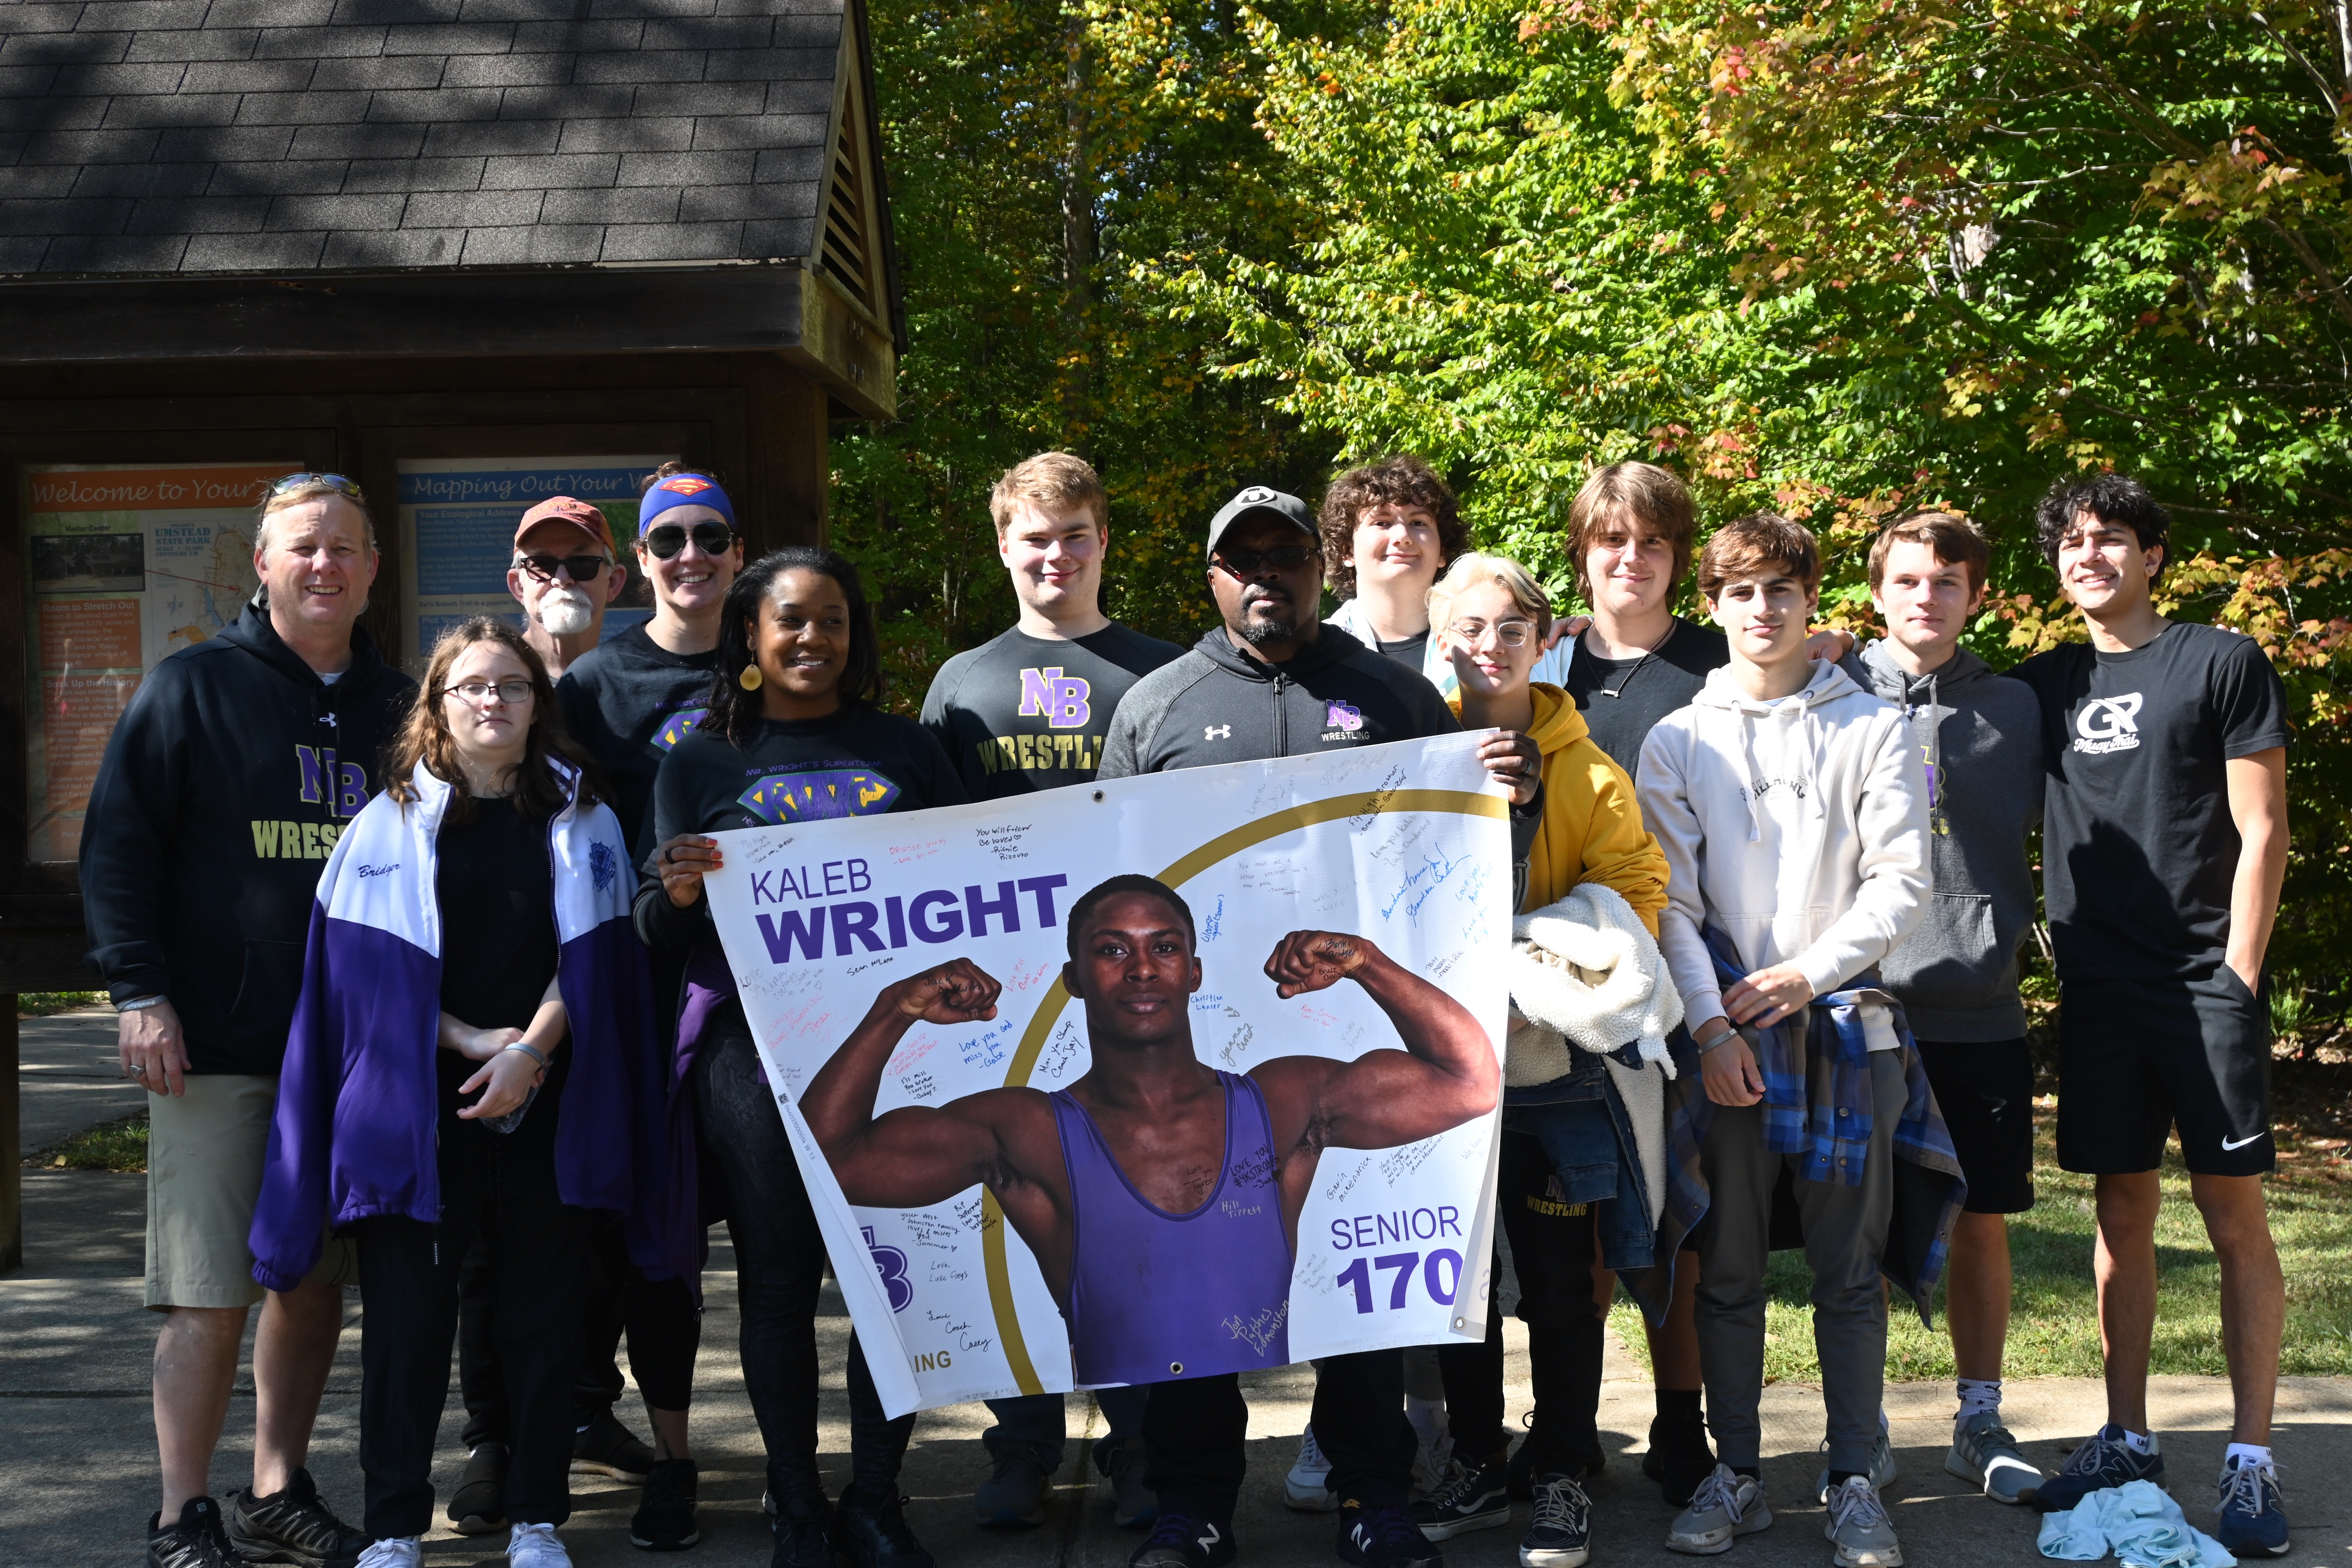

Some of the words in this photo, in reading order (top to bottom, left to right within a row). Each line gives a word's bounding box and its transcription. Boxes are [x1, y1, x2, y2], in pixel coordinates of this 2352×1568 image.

[33, 481, 153, 504] Welcome
[158, 480, 189, 500] to
[192, 479, 256, 499] Your
[414, 477, 517, 500] Mapping
[520, 475, 566, 493] Out
[569, 474, 622, 491] Your
[441, 510, 484, 519] Ecological
[155, 527, 211, 537] UMSTEAD
[84, 602, 115, 610] Stretch
[46, 680, 68, 688] Soak
[71, 679, 84, 689] Up
[87, 678, 101, 686] the
[103, 678, 135, 688] History
[1018, 667, 1091, 728] NB
[1326, 699, 1363, 731] NB
[1321, 731, 1370, 741] WRESTLING
[2074, 738, 2111, 754] Muay
[2109, 733, 2140, 749] Thai
[977, 734, 1108, 776] WRESTLI
[746, 769, 764, 777] MR.
[768, 760, 819, 773] WRIGHT'S
[295, 744, 370, 818] NB
[251, 820, 347, 859] WRES
[358, 863, 400, 878] Bridger
[751, 858, 872, 906] KALEB
[755, 873, 1067, 964] WRIGHT
[847, 967, 868, 976] Sean
[1527, 1195, 1587, 1217] WRESTLING
[1331, 1206, 1462, 1250] SENIOR
[1337, 1248, 1463, 1314] 170
[913, 1350, 951, 1374] ING
